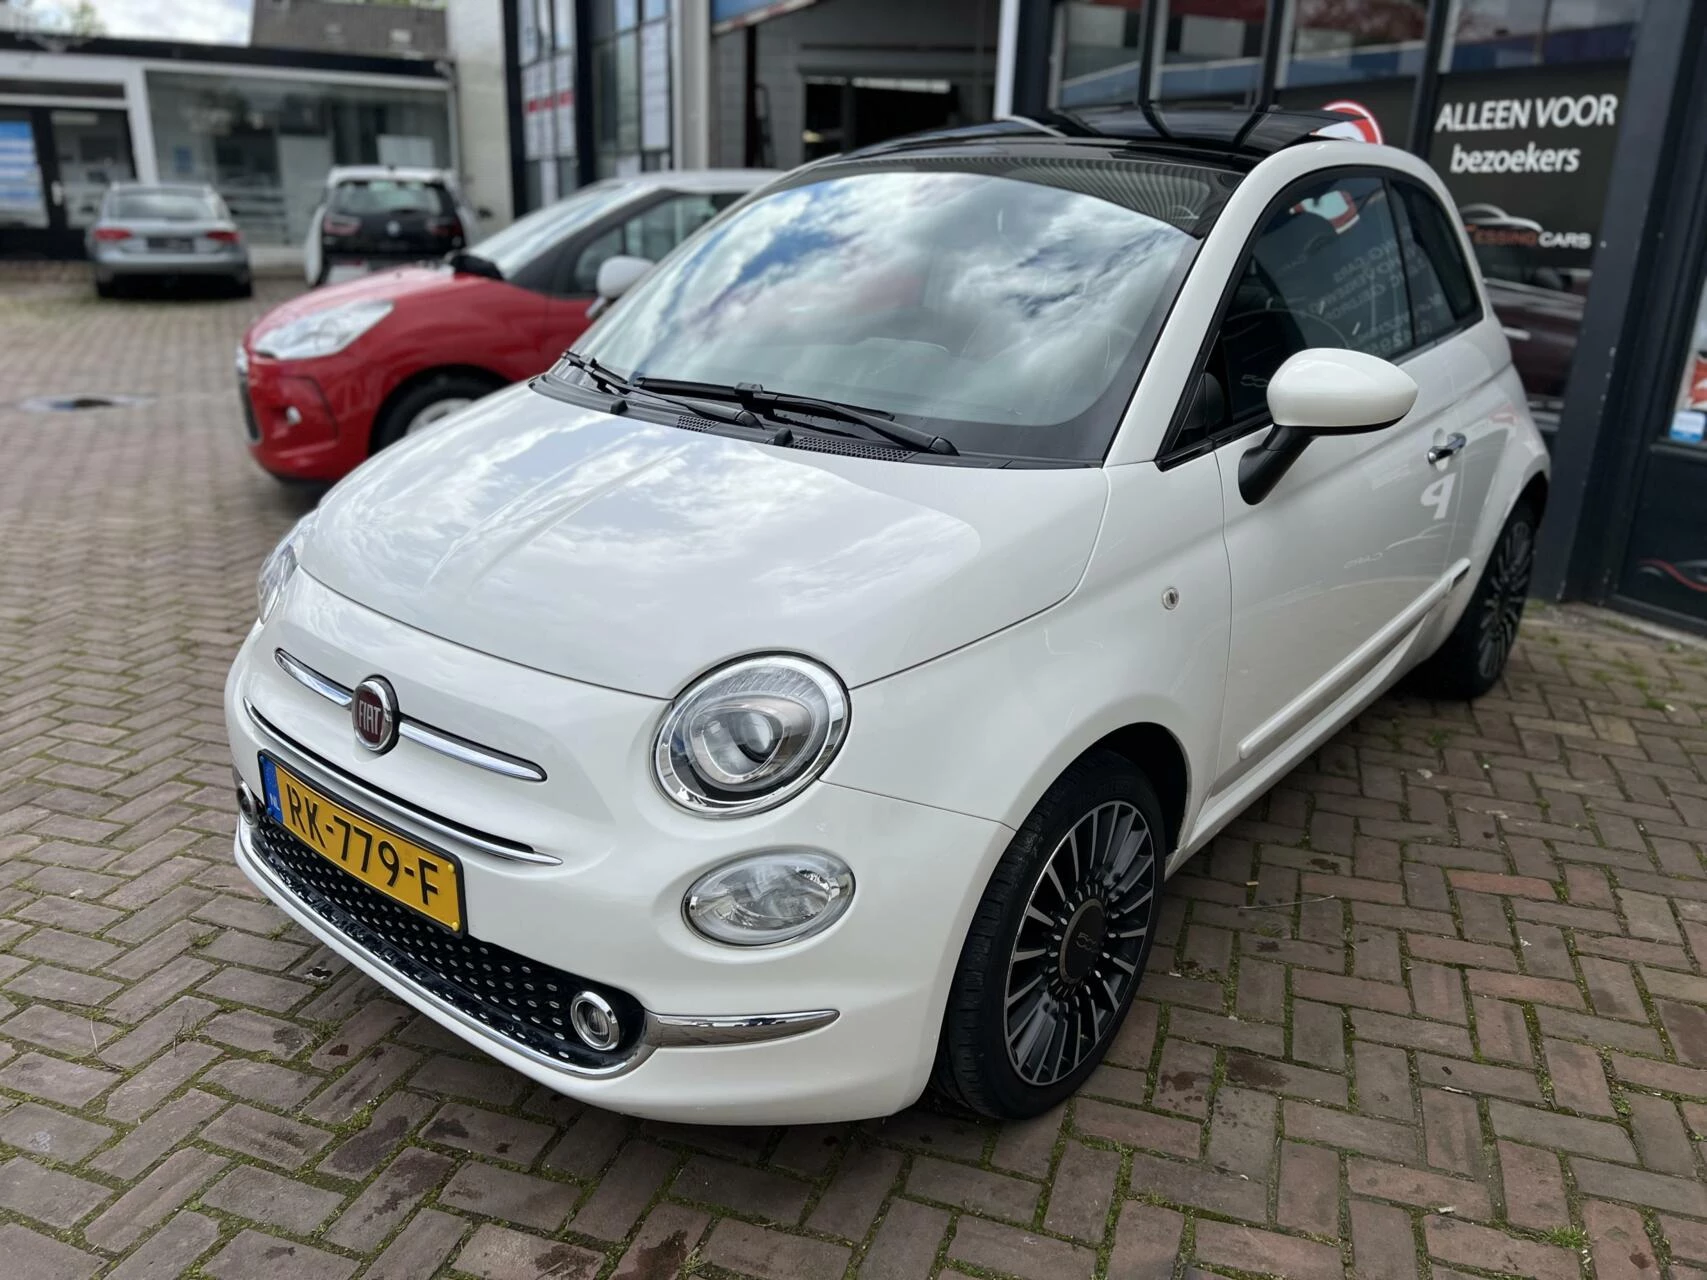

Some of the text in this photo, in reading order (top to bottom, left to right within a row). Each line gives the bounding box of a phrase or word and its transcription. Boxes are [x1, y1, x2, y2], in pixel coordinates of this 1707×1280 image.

[1434, 94, 1618, 132] ALLEEN VOOR
[1450, 142, 1581, 173] bezoekers
[1539, 231, 1592, 249] CARS
[359, 701, 381, 734] FIAT
[286, 784, 438, 905] RK-779-F
